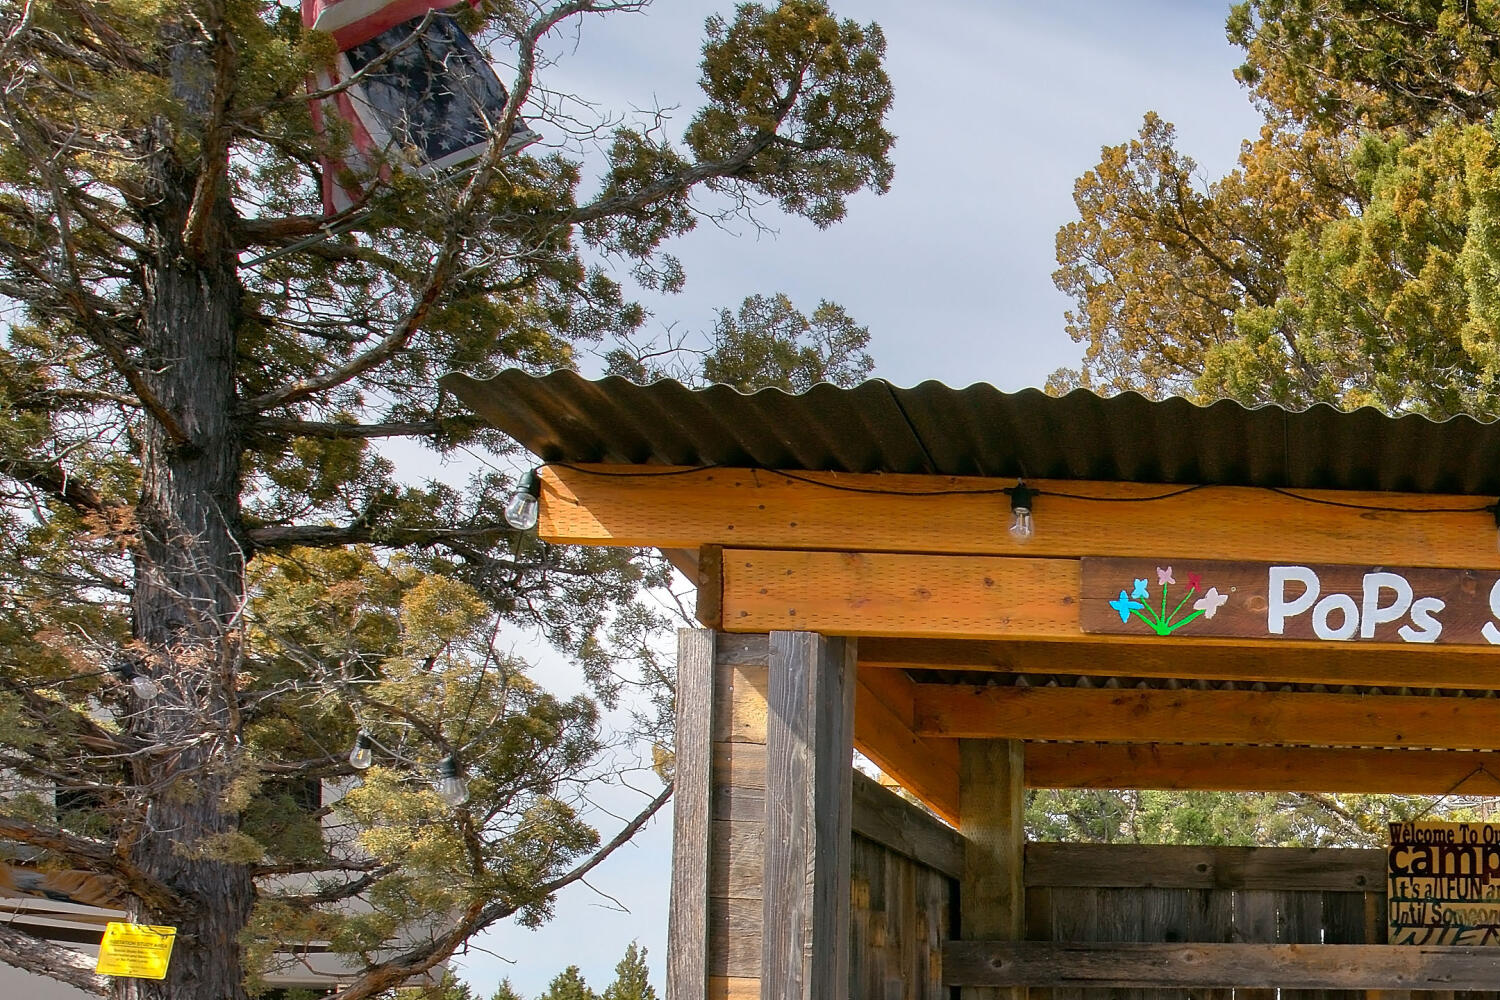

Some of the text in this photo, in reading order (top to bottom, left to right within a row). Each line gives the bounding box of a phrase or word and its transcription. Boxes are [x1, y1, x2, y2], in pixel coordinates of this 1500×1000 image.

[1390, 823, 1455, 845] Welcome
[1459, 824, 1478, 844] To
[1391, 877, 1420, 900] It's
[1424, 877, 1445, 900] all
[1447, 877, 1483, 900] FUN
[1390, 902, 1427, 926] Until
